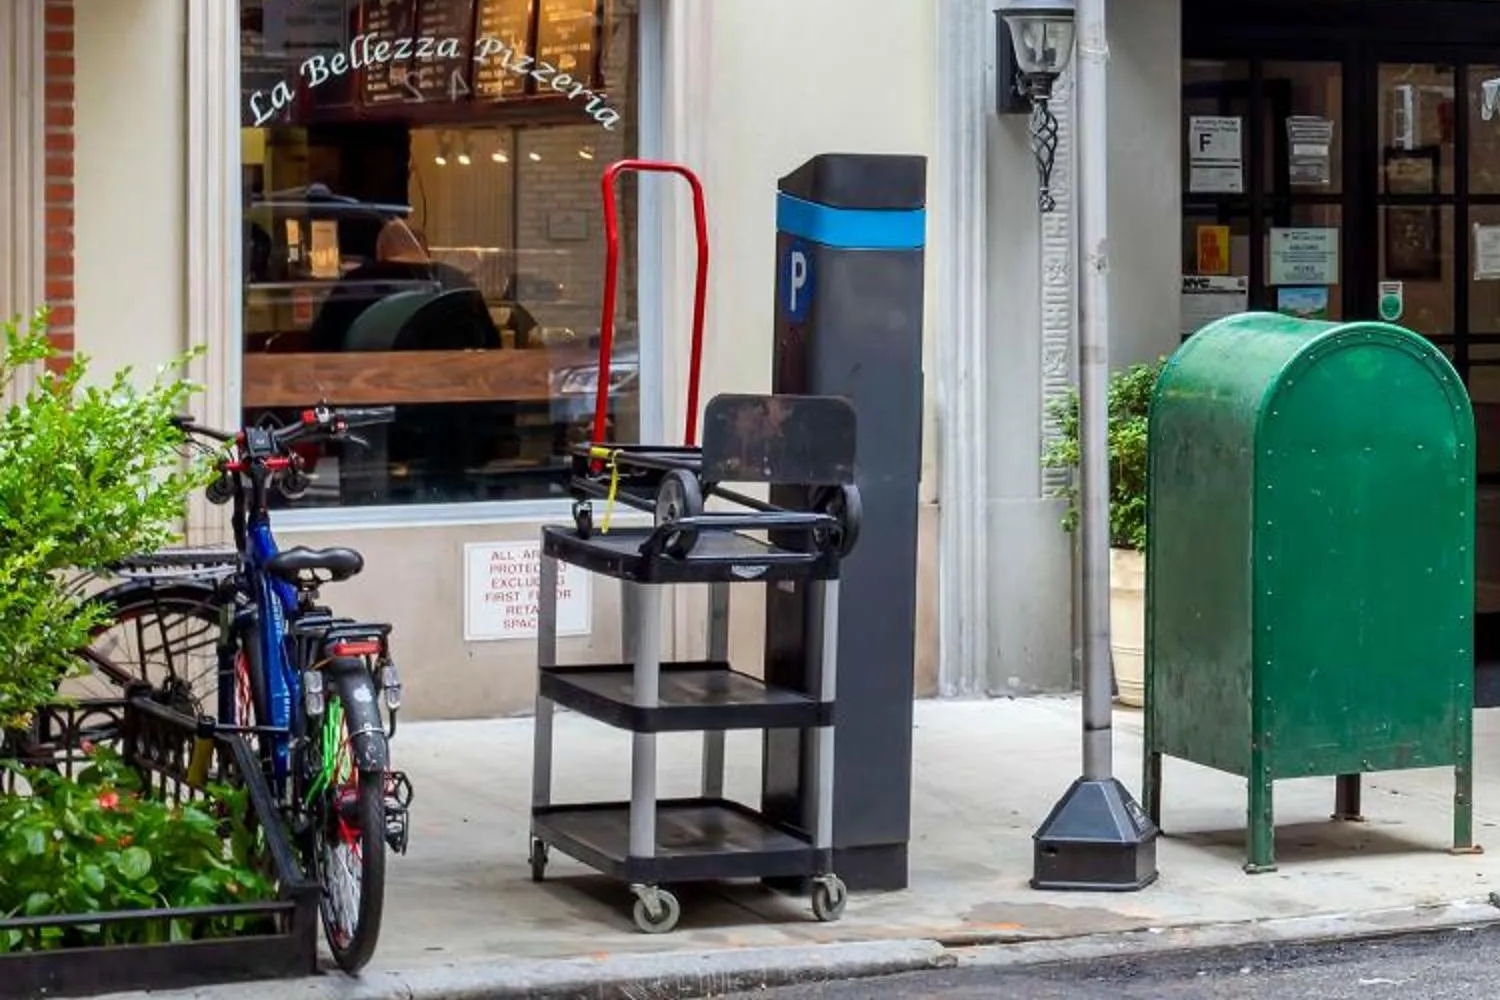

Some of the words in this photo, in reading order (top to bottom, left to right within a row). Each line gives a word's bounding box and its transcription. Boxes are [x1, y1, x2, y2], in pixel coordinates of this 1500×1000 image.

[250, 80, 295, 127] La
[300, 32, 460, 88] Bellezza
[473, 36, 620, 130] Pizzeria
[790, 251, 807, 312] P
[491, 551, 514, 561] ALL
